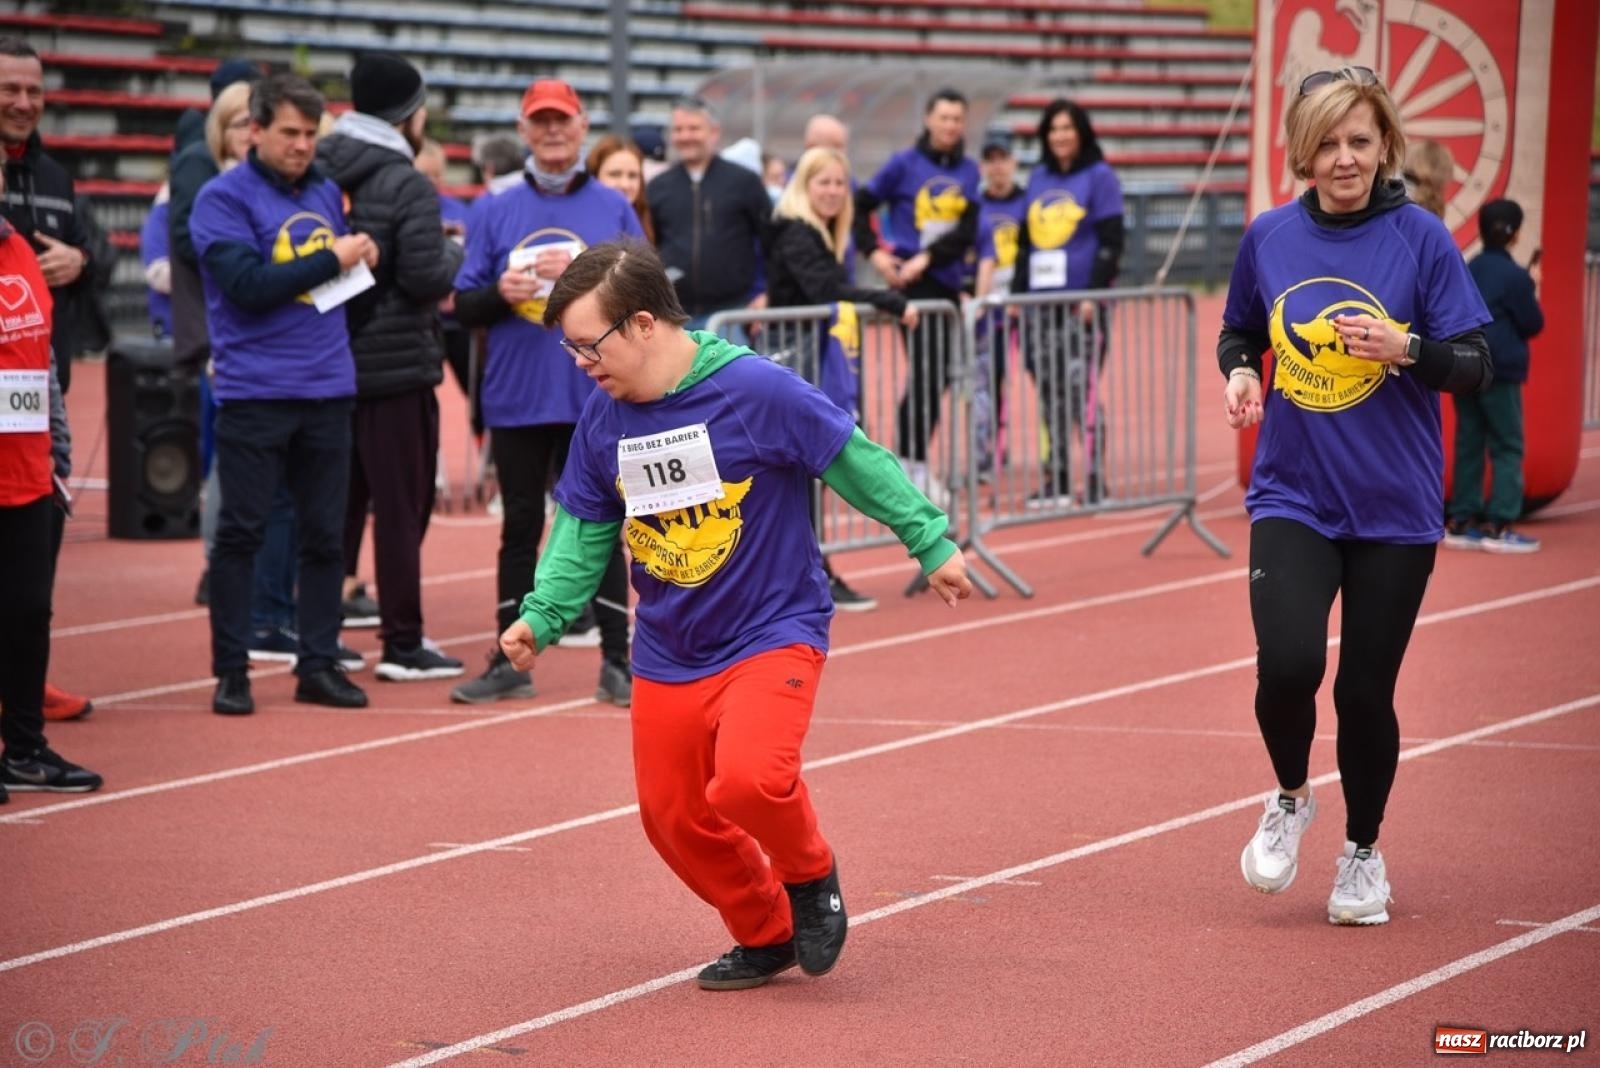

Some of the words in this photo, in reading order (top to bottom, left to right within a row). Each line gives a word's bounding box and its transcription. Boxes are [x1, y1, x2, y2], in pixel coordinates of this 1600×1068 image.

[10, 392, 40, 410] 003
[1322, 393, 1336, 403] BEZ
[627, 443, 644, 453] BIEG
[646, 439, 662, 450] BEZ
[664, 431, 699, 446] BARIER
[642, 458, 686, 488] 118
[679, 569, 694, 579] BEZ
[695, 553, 720, 576] BARIER
